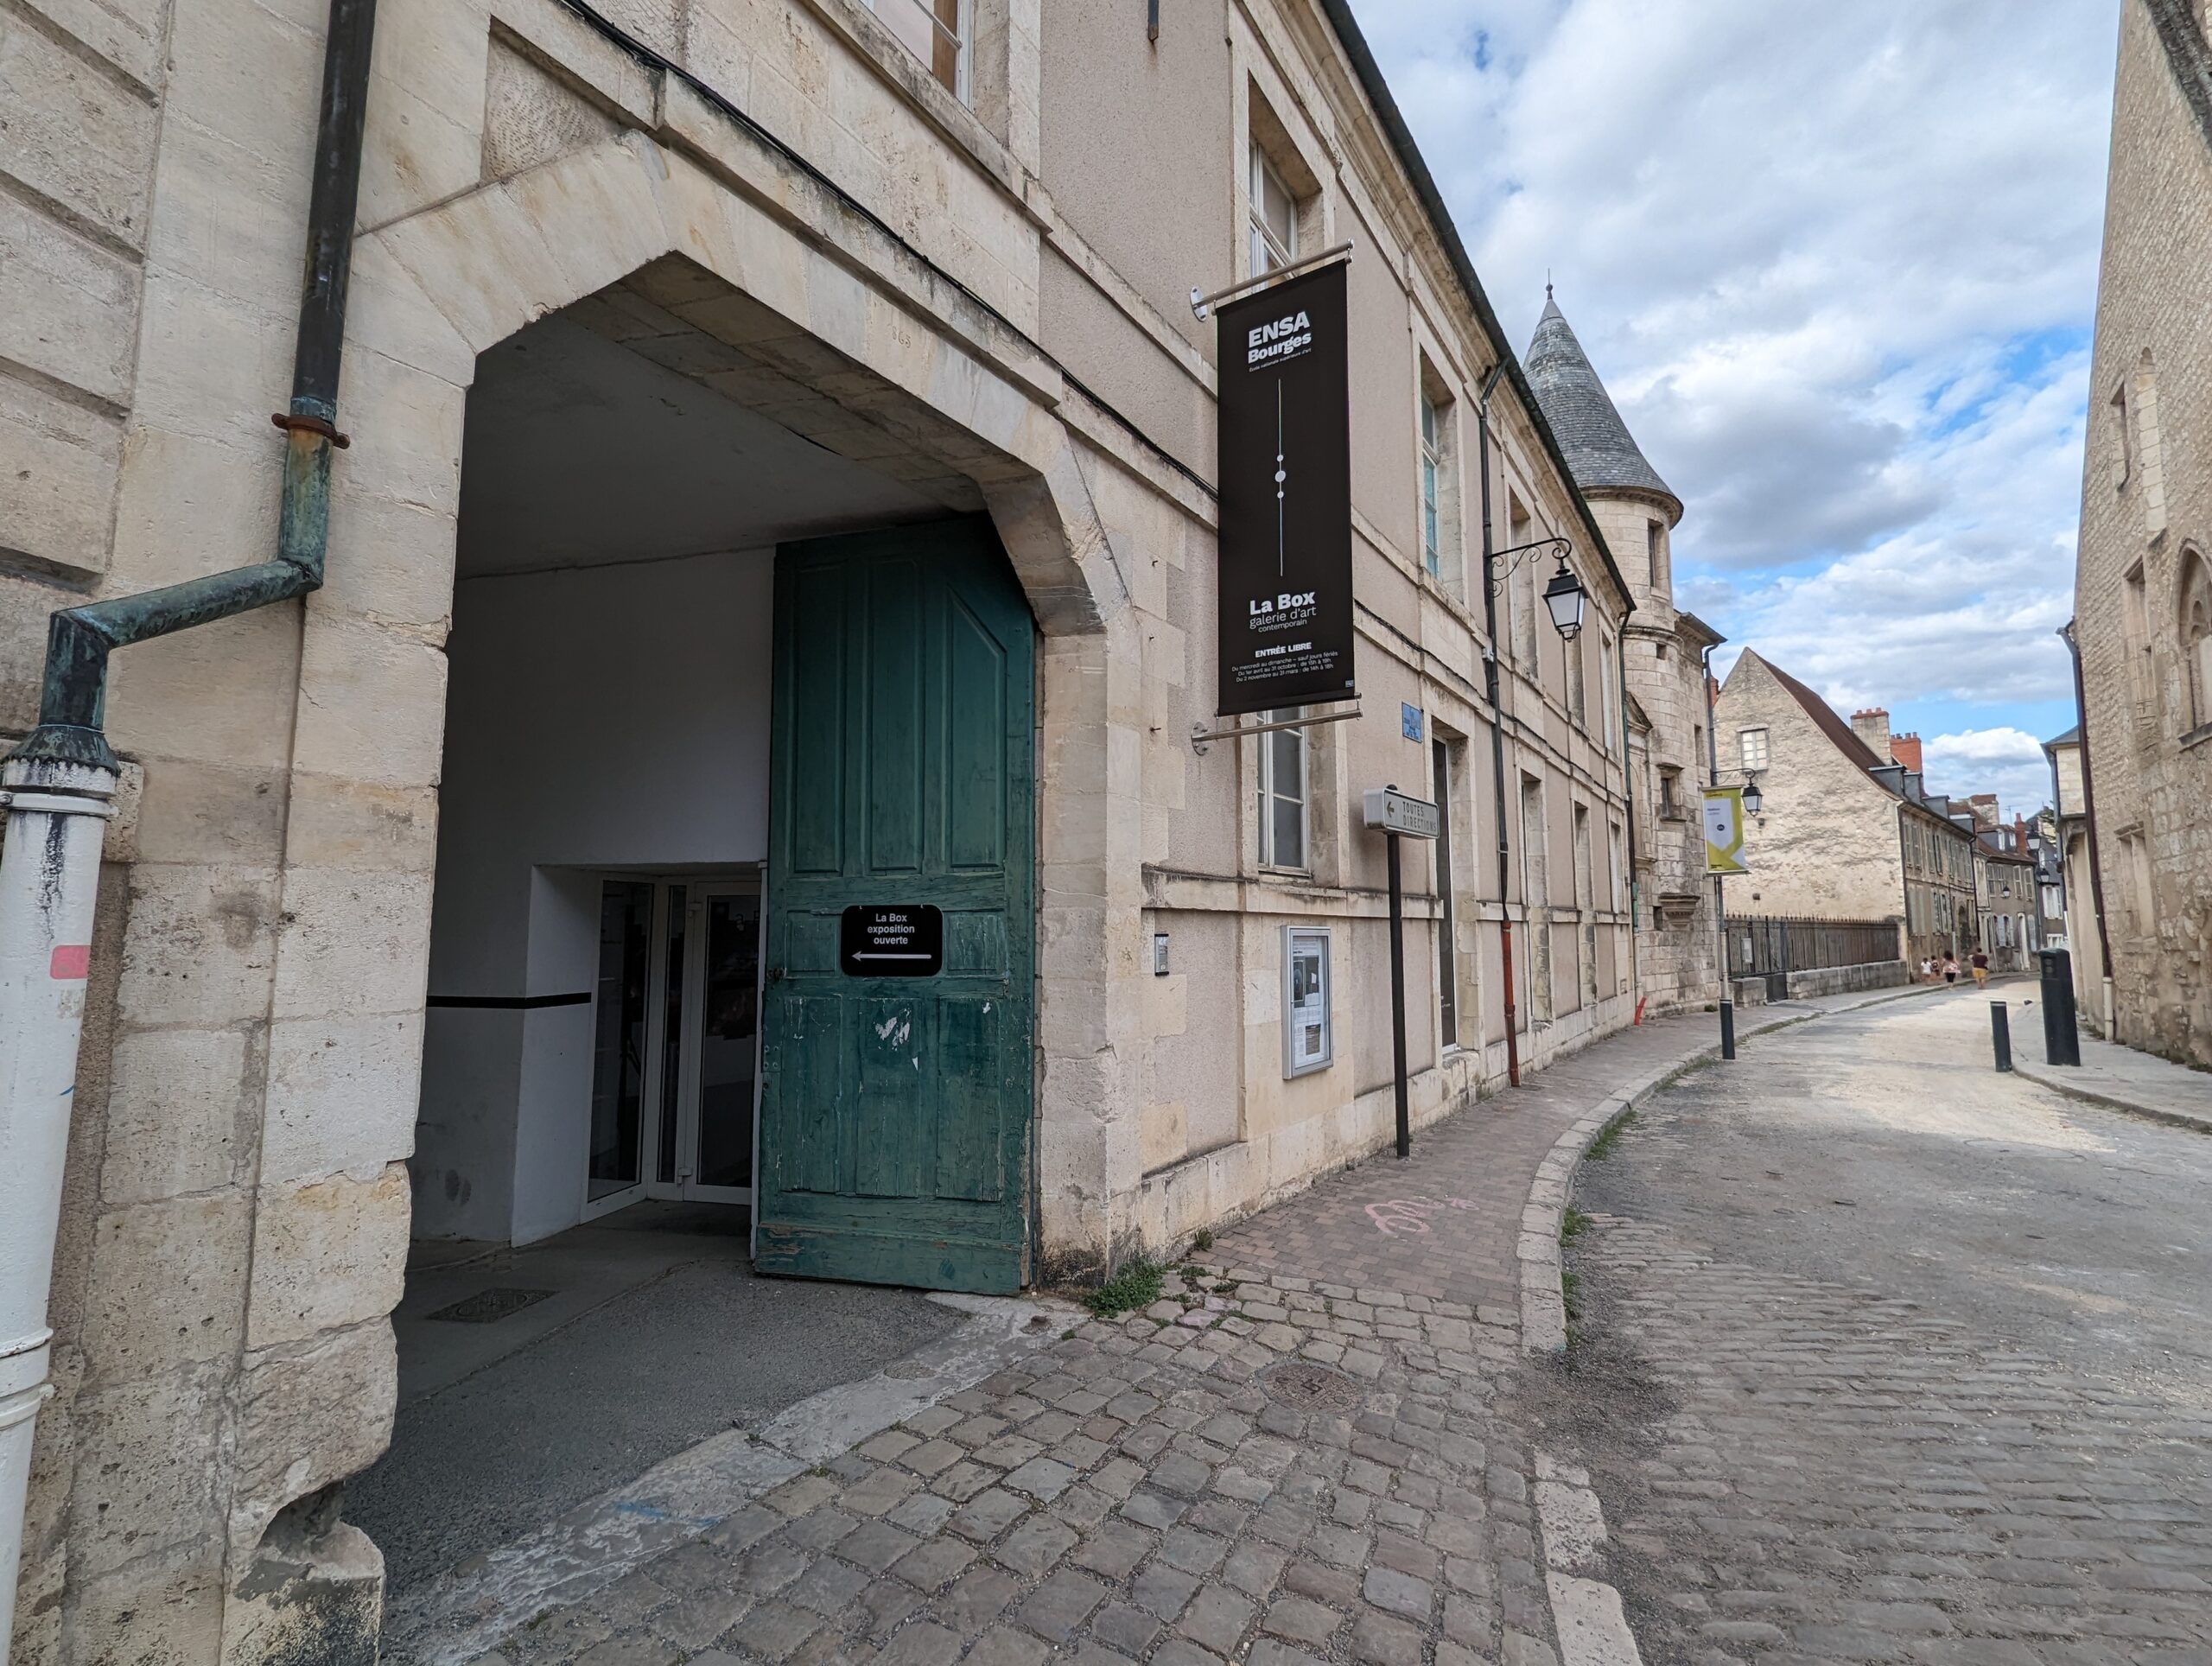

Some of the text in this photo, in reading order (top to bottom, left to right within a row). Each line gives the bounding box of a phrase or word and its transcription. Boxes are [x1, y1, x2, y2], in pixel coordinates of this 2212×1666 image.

[1249, 311, 1310, 348] ENSA
[1248, 333, 1312, 364] Bourges
[1249, 592, 1316, 615] La Box
[1249, 607, 1317, 630] galerie d'art
[1258, 619, 1307, 633] contemporain
[1255, 642, 1312, 658] ENTRÉE LIBRE
[1239, 662, 1261, 671] mercredi
[1268, 658, 1292, 666] dimanche
[1298, 653, 1309, 662] sauf
[1248, 672, 1272, 681] novembre
[1402, 801, 1424, 817] TOUTES
[1402, 814, 1437, 832] DIRECTIONS
[875, 912, 907, 923] La Box
[867, 924, 915, 935] exposition
[874, 936, 908, 944] ouverte
